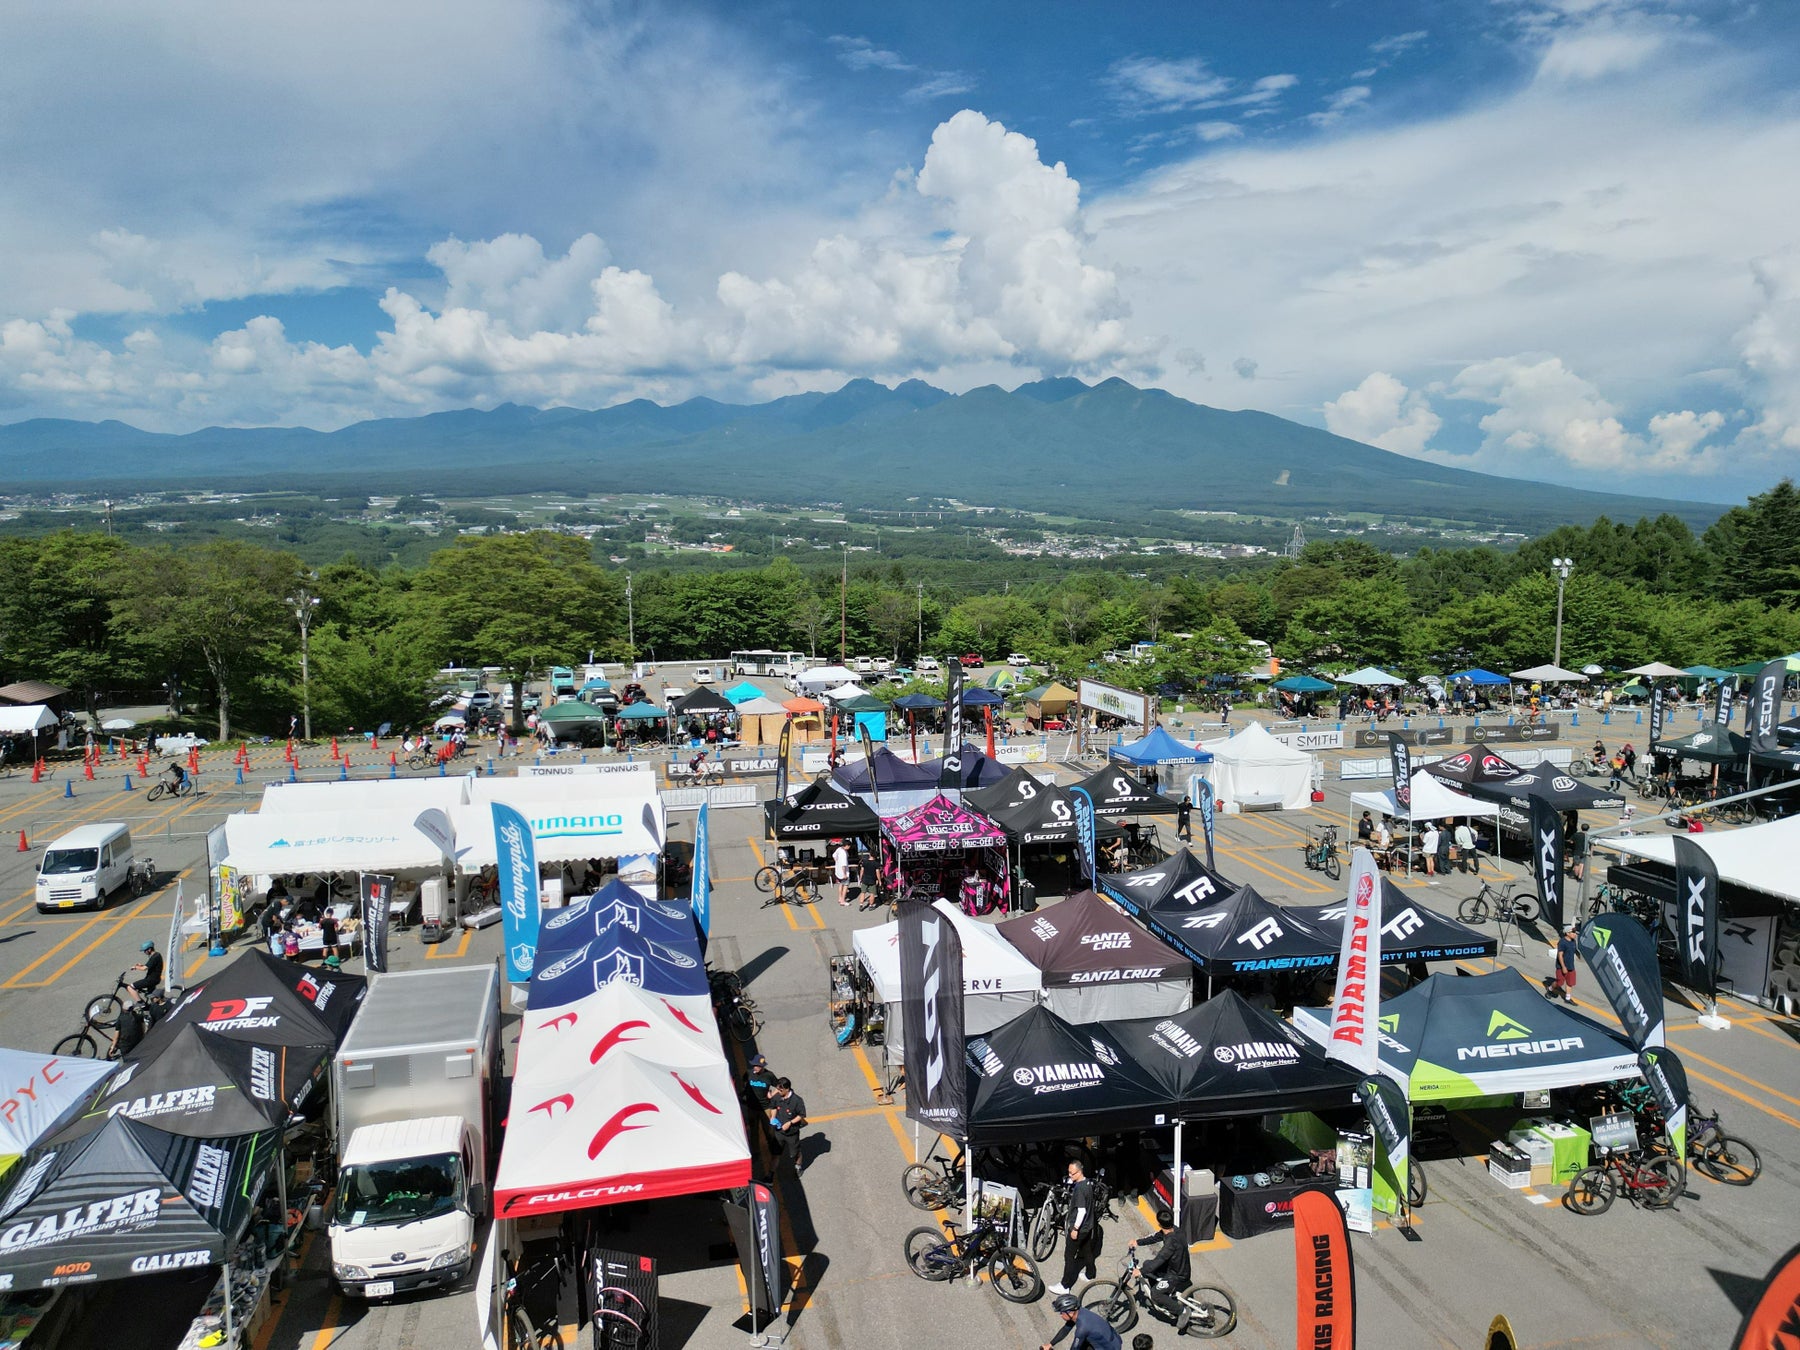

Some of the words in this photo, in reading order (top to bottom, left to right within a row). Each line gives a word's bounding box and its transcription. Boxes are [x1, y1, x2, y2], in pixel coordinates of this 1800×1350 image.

[1297, 735, 1338, 747] SMITH
[731, 759, 779, 771] FUKAY
[1394, 743, 1409, 788] Yuris
[532, 814, 622, 830] IMANO
[929, 824, 971, 834] Muc-Off
[915, 841, 945, 849] Muc-Off
[964, 838, 992, 847] Muc-Off
[501, 820, 530, 931] Campagnolo
[1101, 882, 1140, 916] TRANSITION
[1030, 924, 1051, 942] CRUZ
[1034, 916, 1060, 938] SANTA
[1080, 932, 1131, 945] SANTA
[1093, 939, 1132, 951] CRUZ
[1380, 953, 1403, 961] RTY
[1420, 949, 1441, 957] THE
[1445, 946, 1485, 955] WOODS
[1232, 954, 1335, 972] TRANSITION
[962, 979, 1002, 990] ERVE
[1069, 969, 1121, 984] SANTA
[1121, 967, 1166, 980] CRUZ
[1162, 1024, 1202, 1058] YAMAHA
[1457, 1037, 1584, 1061] MERIDA
[1231, 1042, 1300, 1060] YAMAHA
[251, 1047, 269, 1100] GALFER
[1033, 1063, 1104, 1081] YAMAHA
[1235, 1060, 1261, 1072] Revs
[1261, 1060, 1279, 1068] Your
[1033, 1083, 1060, 1095] Revs
[1060, 1082, 1079, 1092] Your
[108, 1085, 215, 1118] GALFER
[187, 1100, 214, 1110] SYSTEMS
[190, 1144, 222, 1206] GALFER
[528, 1184, 643, 1205] FULCRUM
[1, 1188, 161, 1249] GALFER
[72, 1221, 115, 1238] BRAKING
[117, 1211, 159, 1227] SYSTEMS
[53, 1262, 92, 1275] MOTO
[131, 1250, 211, 1272] GALFER
[1312, 1234, 1333, 1317] RACING
